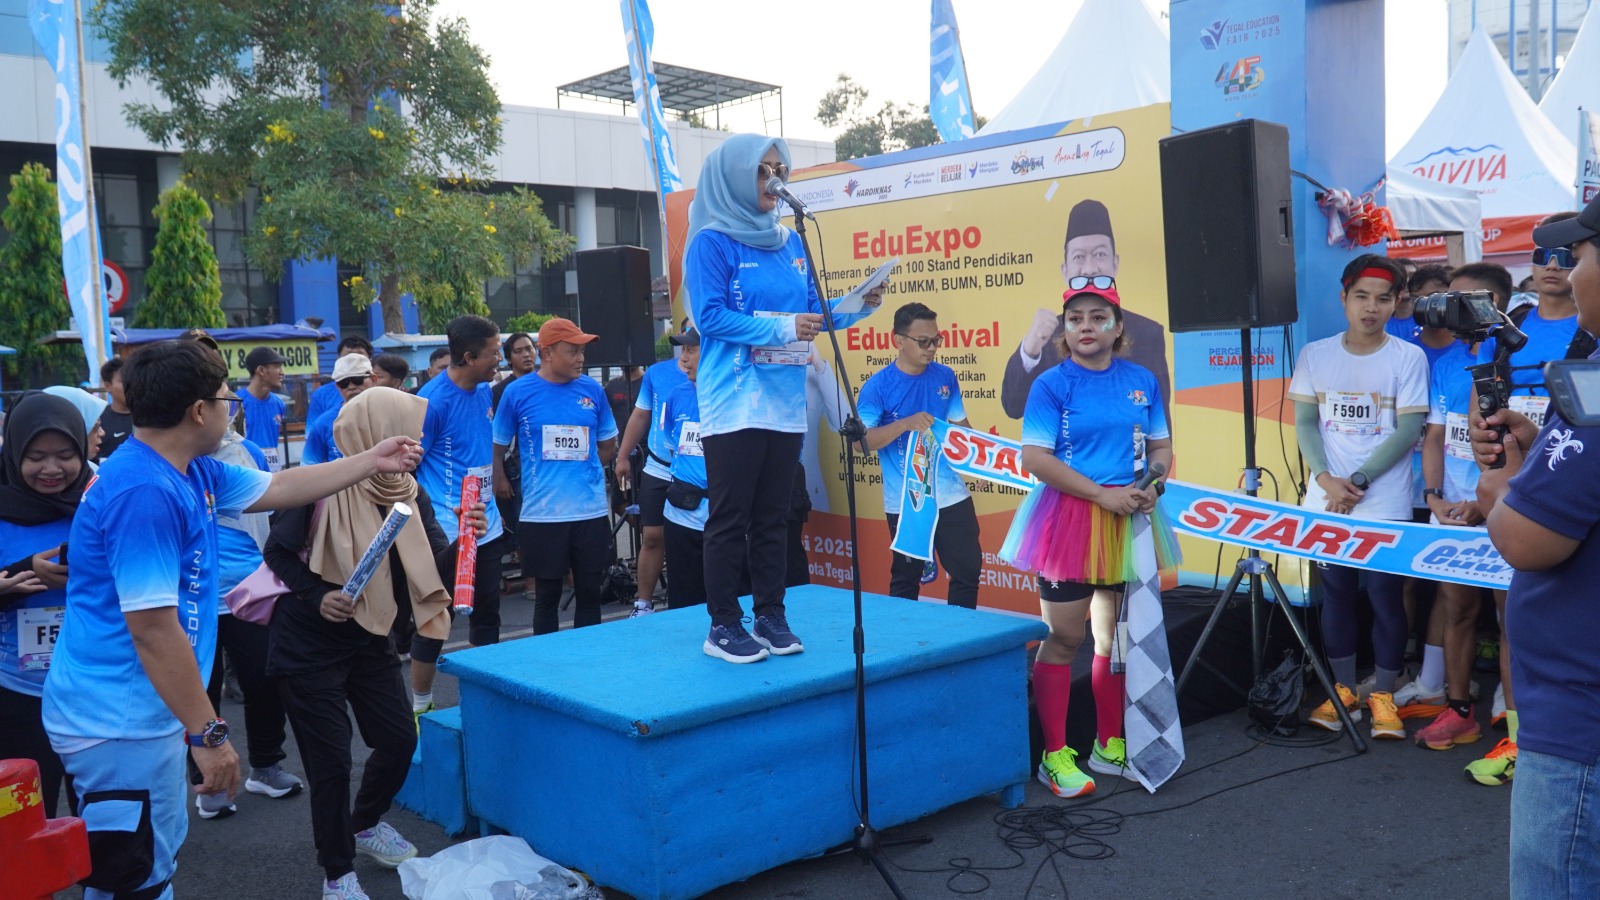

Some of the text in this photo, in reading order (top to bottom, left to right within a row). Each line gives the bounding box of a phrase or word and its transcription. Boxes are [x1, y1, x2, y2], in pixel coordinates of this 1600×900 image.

[856, 184, 892, 198] HARDIKNAS
[852, 225, 982, 260] EduExpo
[905, 260, 924, 273] 100
[927, 257, 960, 272] Stand
[963, 252, 1033, 269] Pendidikan
[899, 279, 939, 294] UMKM,
[941, 275, 982, 291] BUMN,
[985, 272, 1024, 287] BUMD
[733, 279, 745, 311] RUN
[940, 353, 977, 365] tematik
[1062, 409, 1070, 439] RUN
[554, 437, 579, 449] 5023
[1182, 500, 1397, 561] START
[814, 535, 853, 558] 2025
[186, 550, 202, 647] EDU RUN
